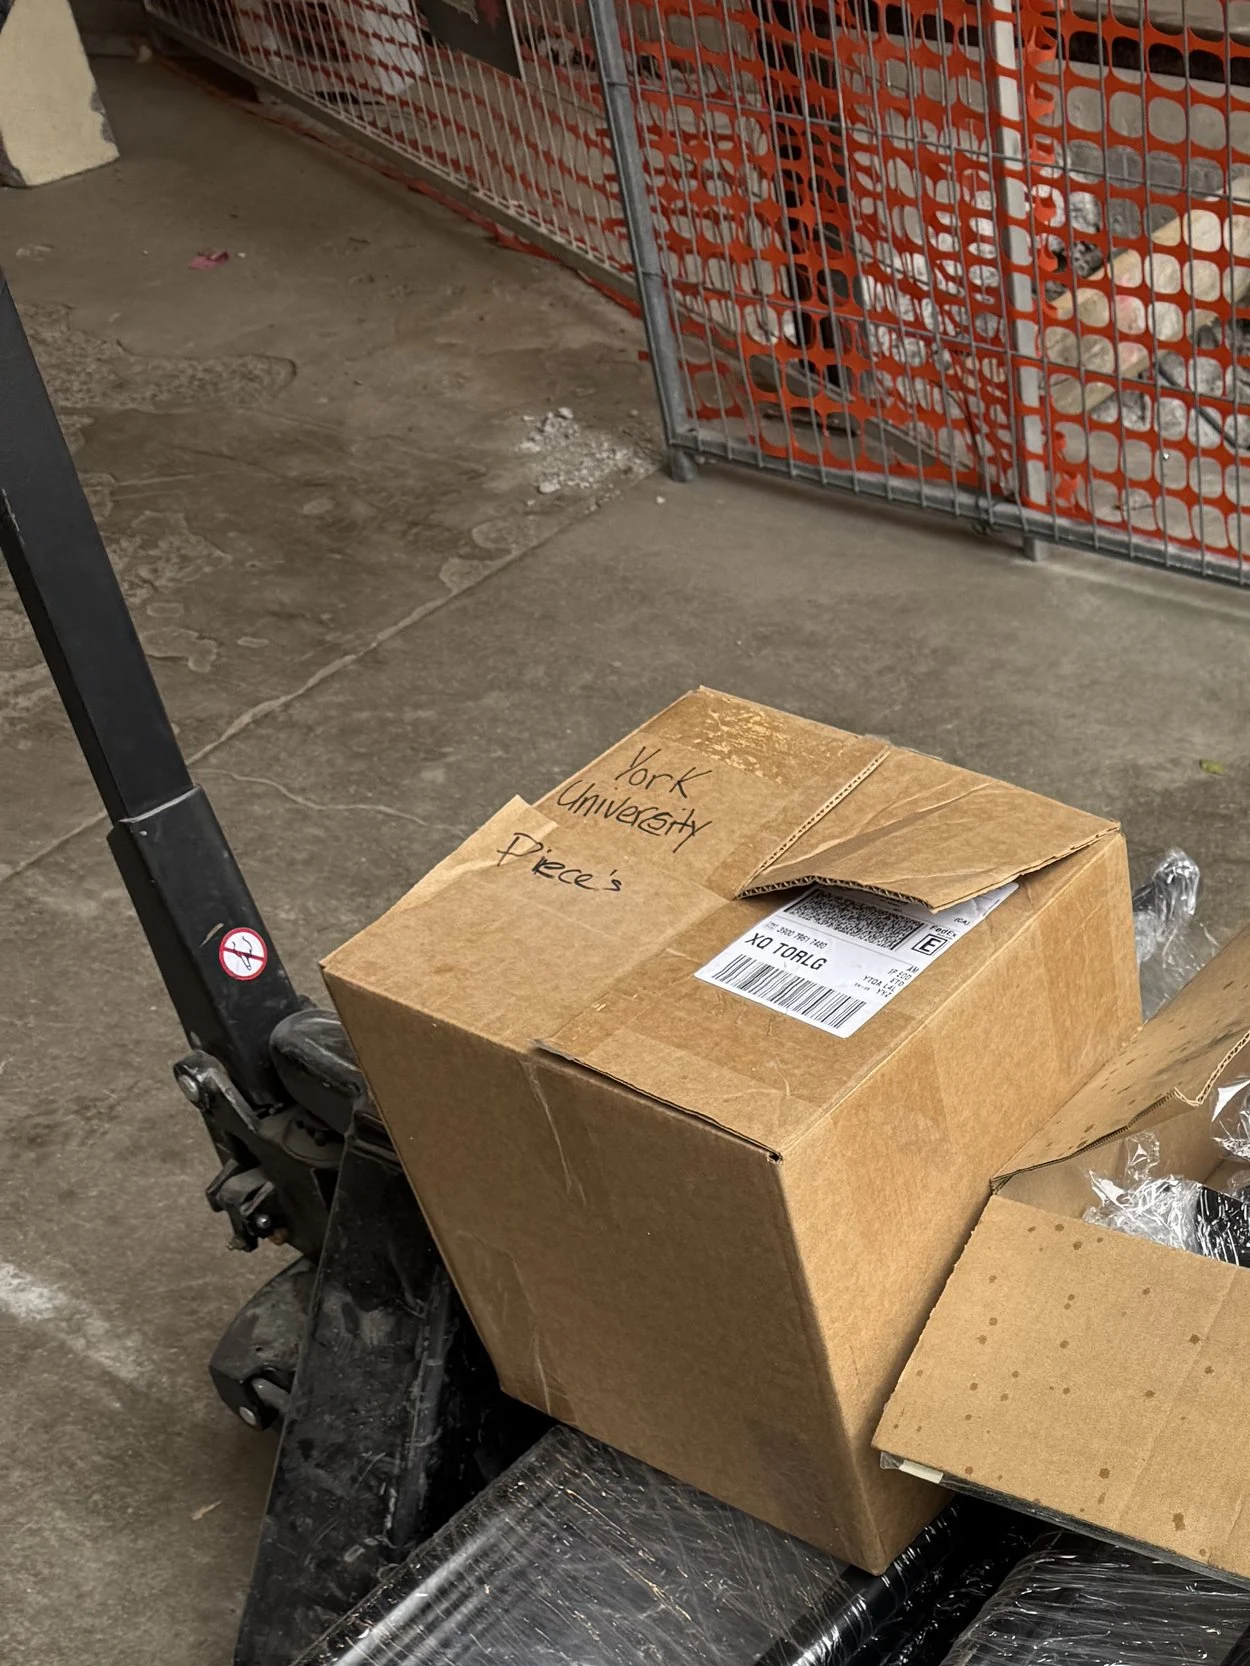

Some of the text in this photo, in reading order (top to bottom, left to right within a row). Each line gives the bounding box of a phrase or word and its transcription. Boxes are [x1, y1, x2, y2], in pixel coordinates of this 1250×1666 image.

[496, 832, 622, 892] Piece's
[929, 925, 958, 938] FedEx
[744, 932, 828, 971] XQ TORLG
[919, 937, 941, 953] E
[887, 968, 898, 976] IP
[905, 965, 920, 974] AM
[876, 987, 893, 998] YYZ
